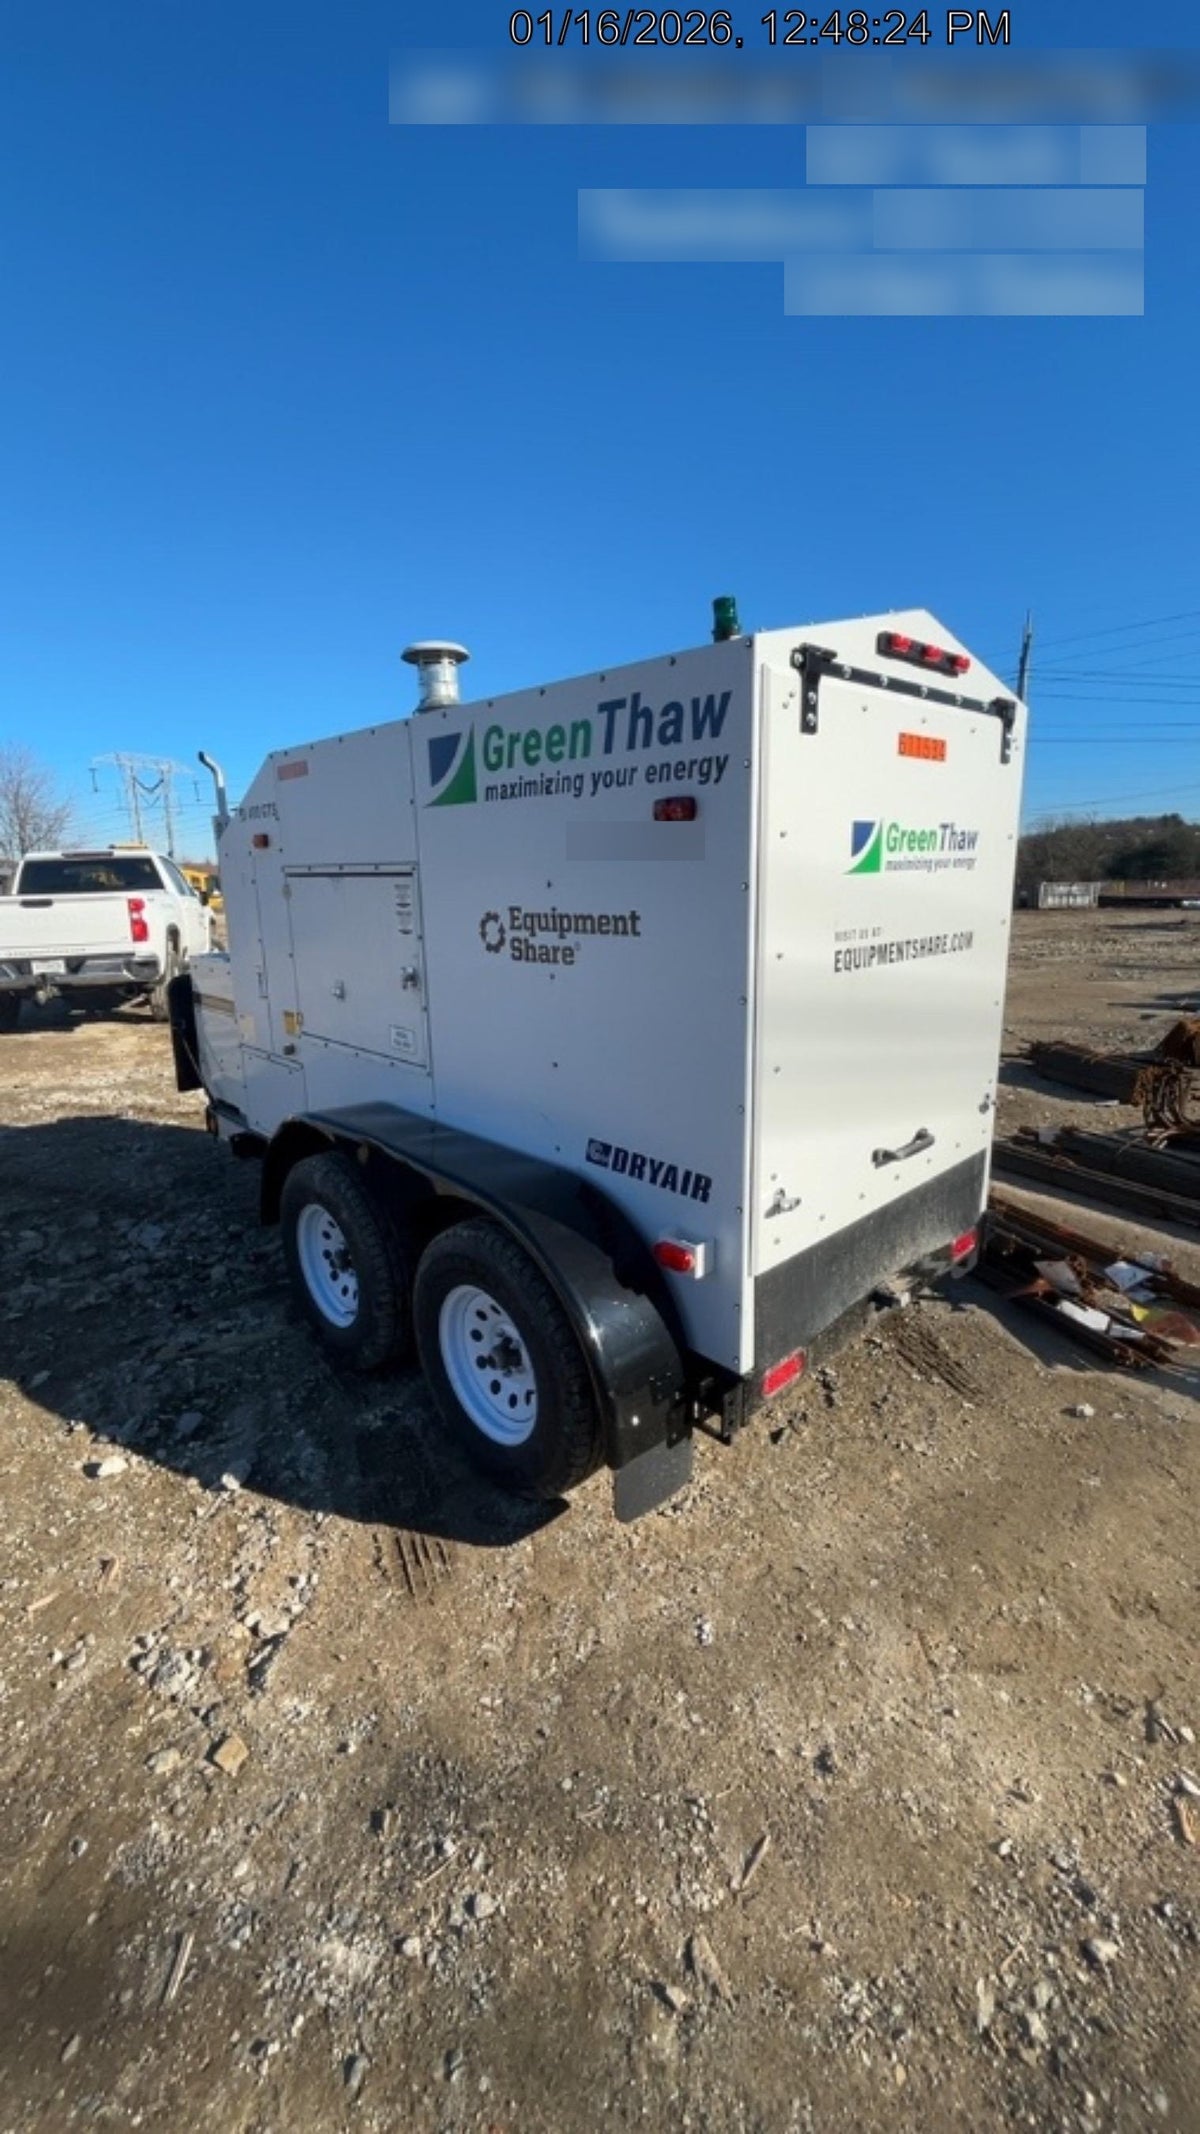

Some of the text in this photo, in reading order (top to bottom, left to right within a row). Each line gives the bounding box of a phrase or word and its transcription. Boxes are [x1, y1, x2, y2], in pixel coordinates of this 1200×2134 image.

[485, 754, 729, 802] maximizing your energy
[508, 905, 641, 939] Equipment
[834, 930, 973, 973] EQUIPMENTSHARE.COM
[611, 1146, 712, 1203] DRYAIR
